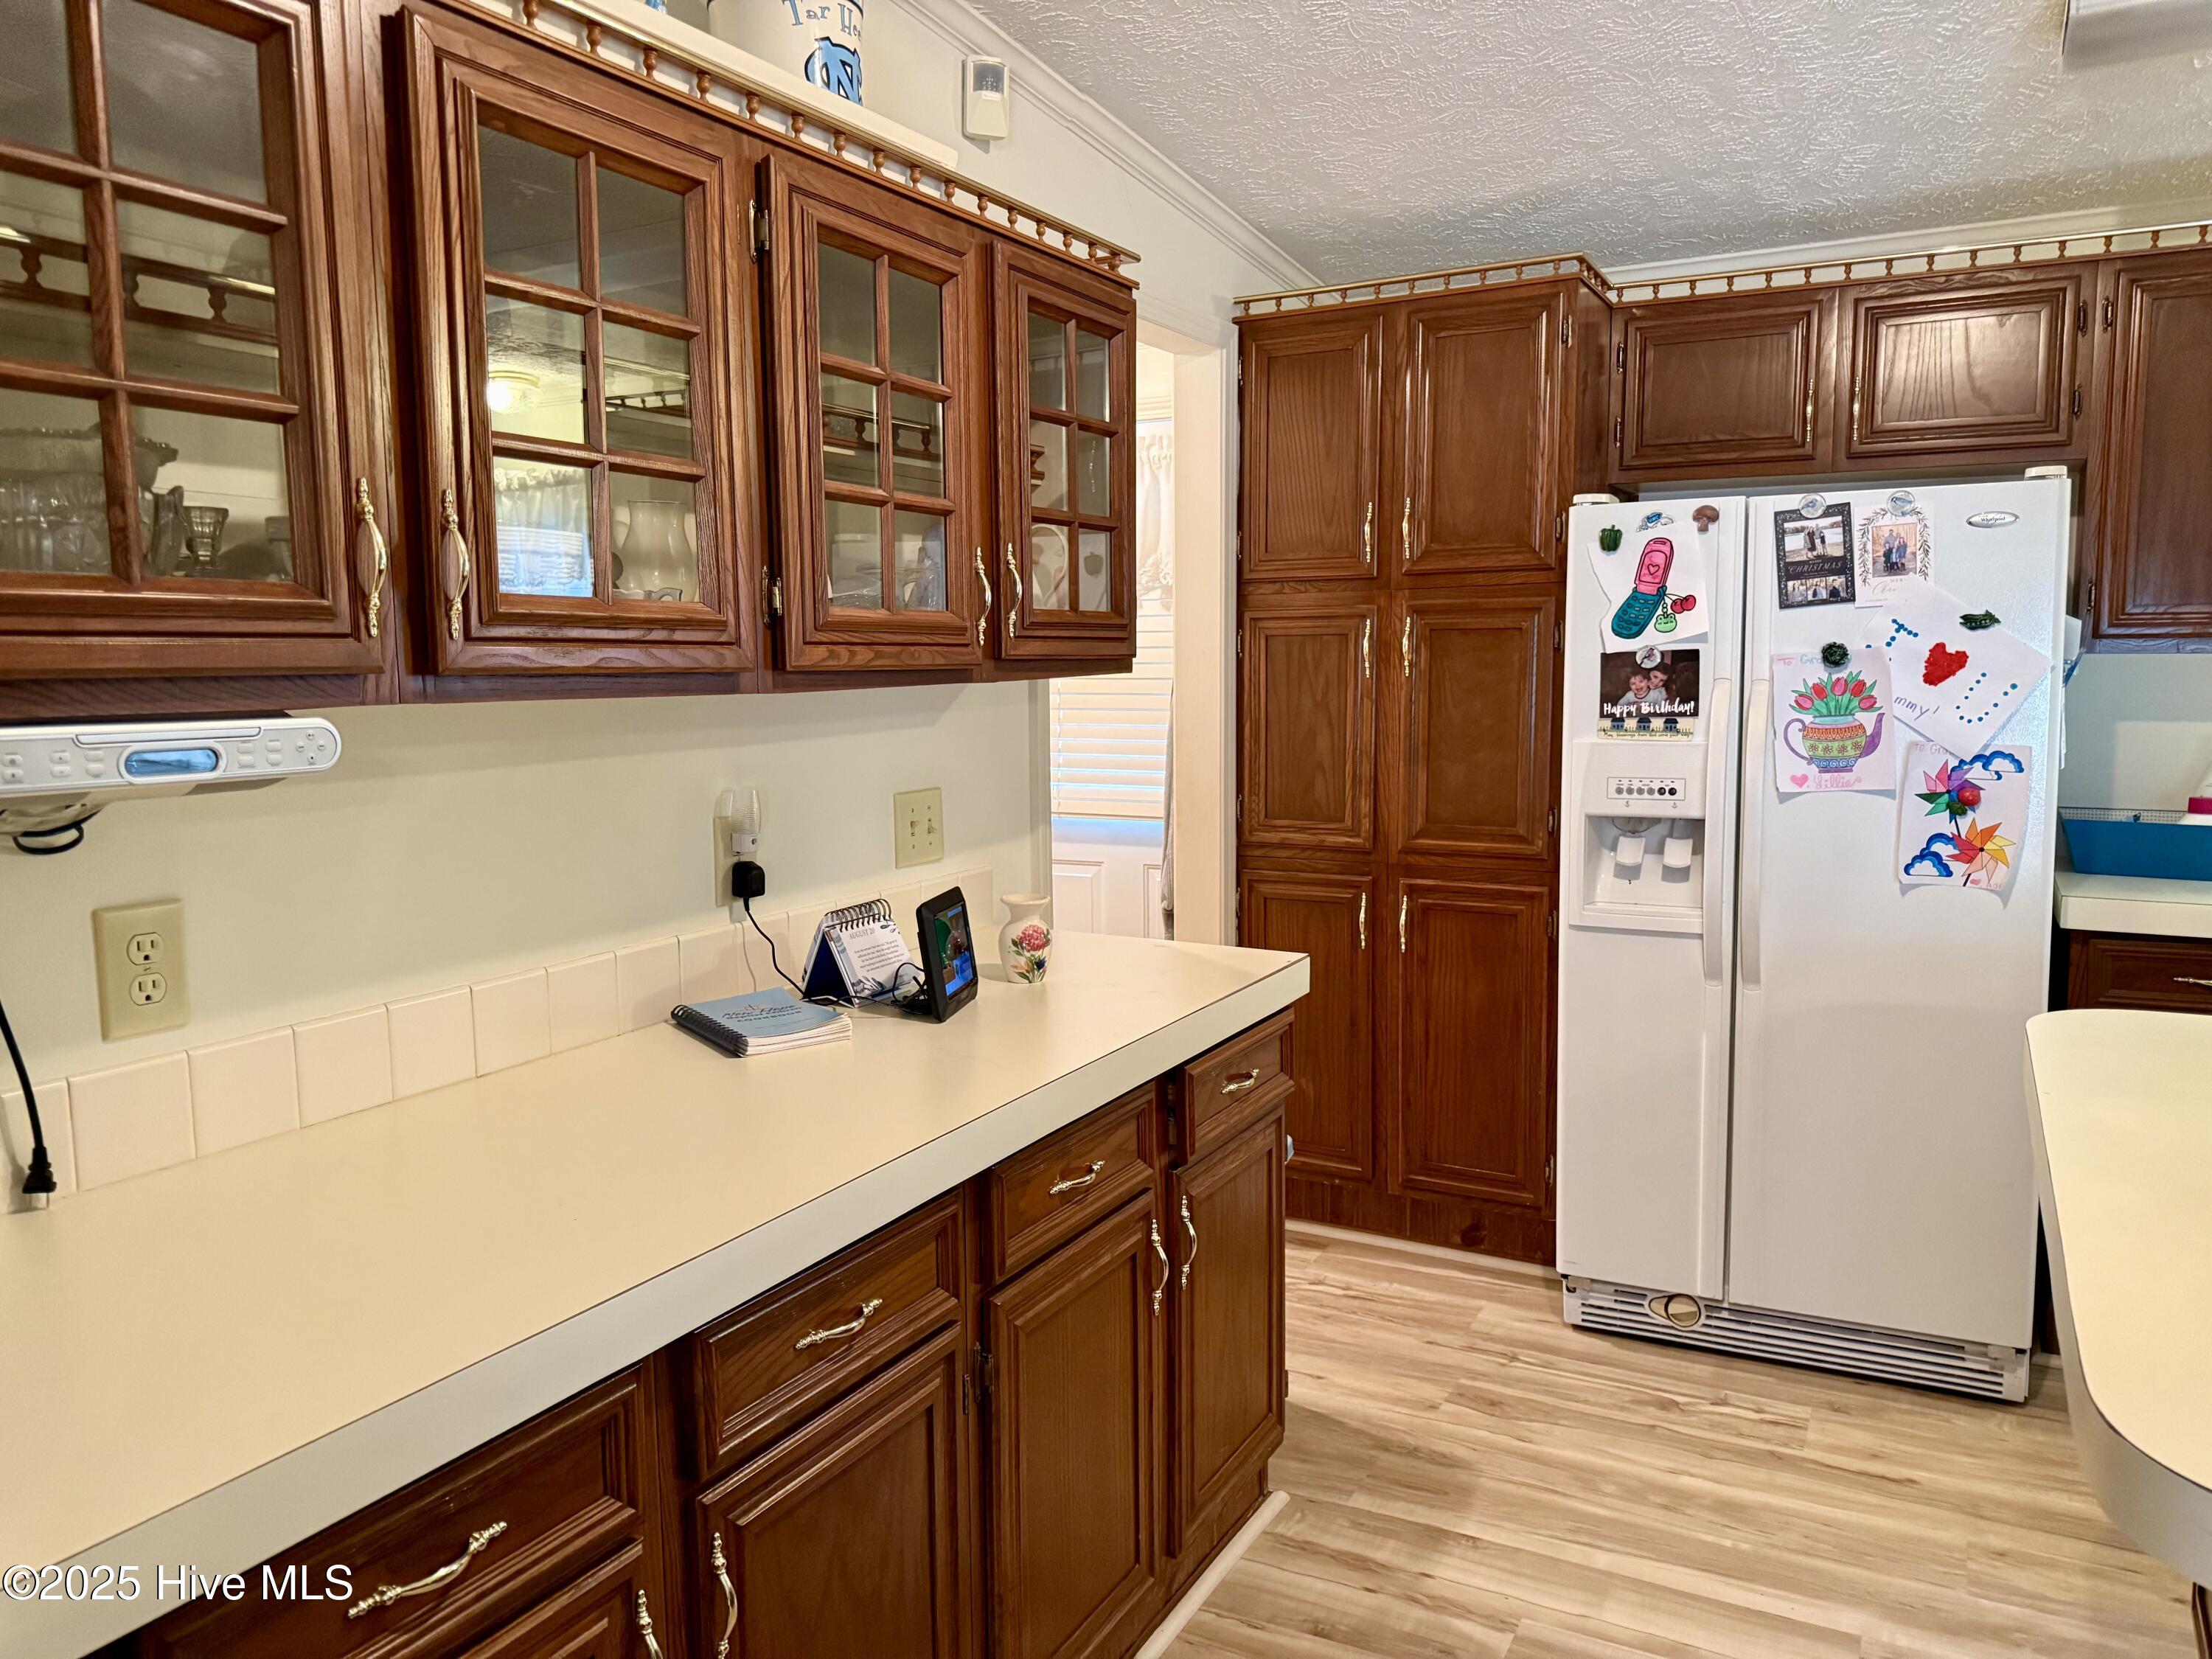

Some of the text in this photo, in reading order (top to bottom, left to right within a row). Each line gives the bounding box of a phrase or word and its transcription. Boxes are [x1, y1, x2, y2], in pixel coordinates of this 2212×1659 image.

[782, 0, 830, 27] Tar
[1788, 561, 1843, 574] CHRISTMAS
[1603, 697, 1694, 717] Happy Birthday!
[849, 929, 869, 939] AUGUST
